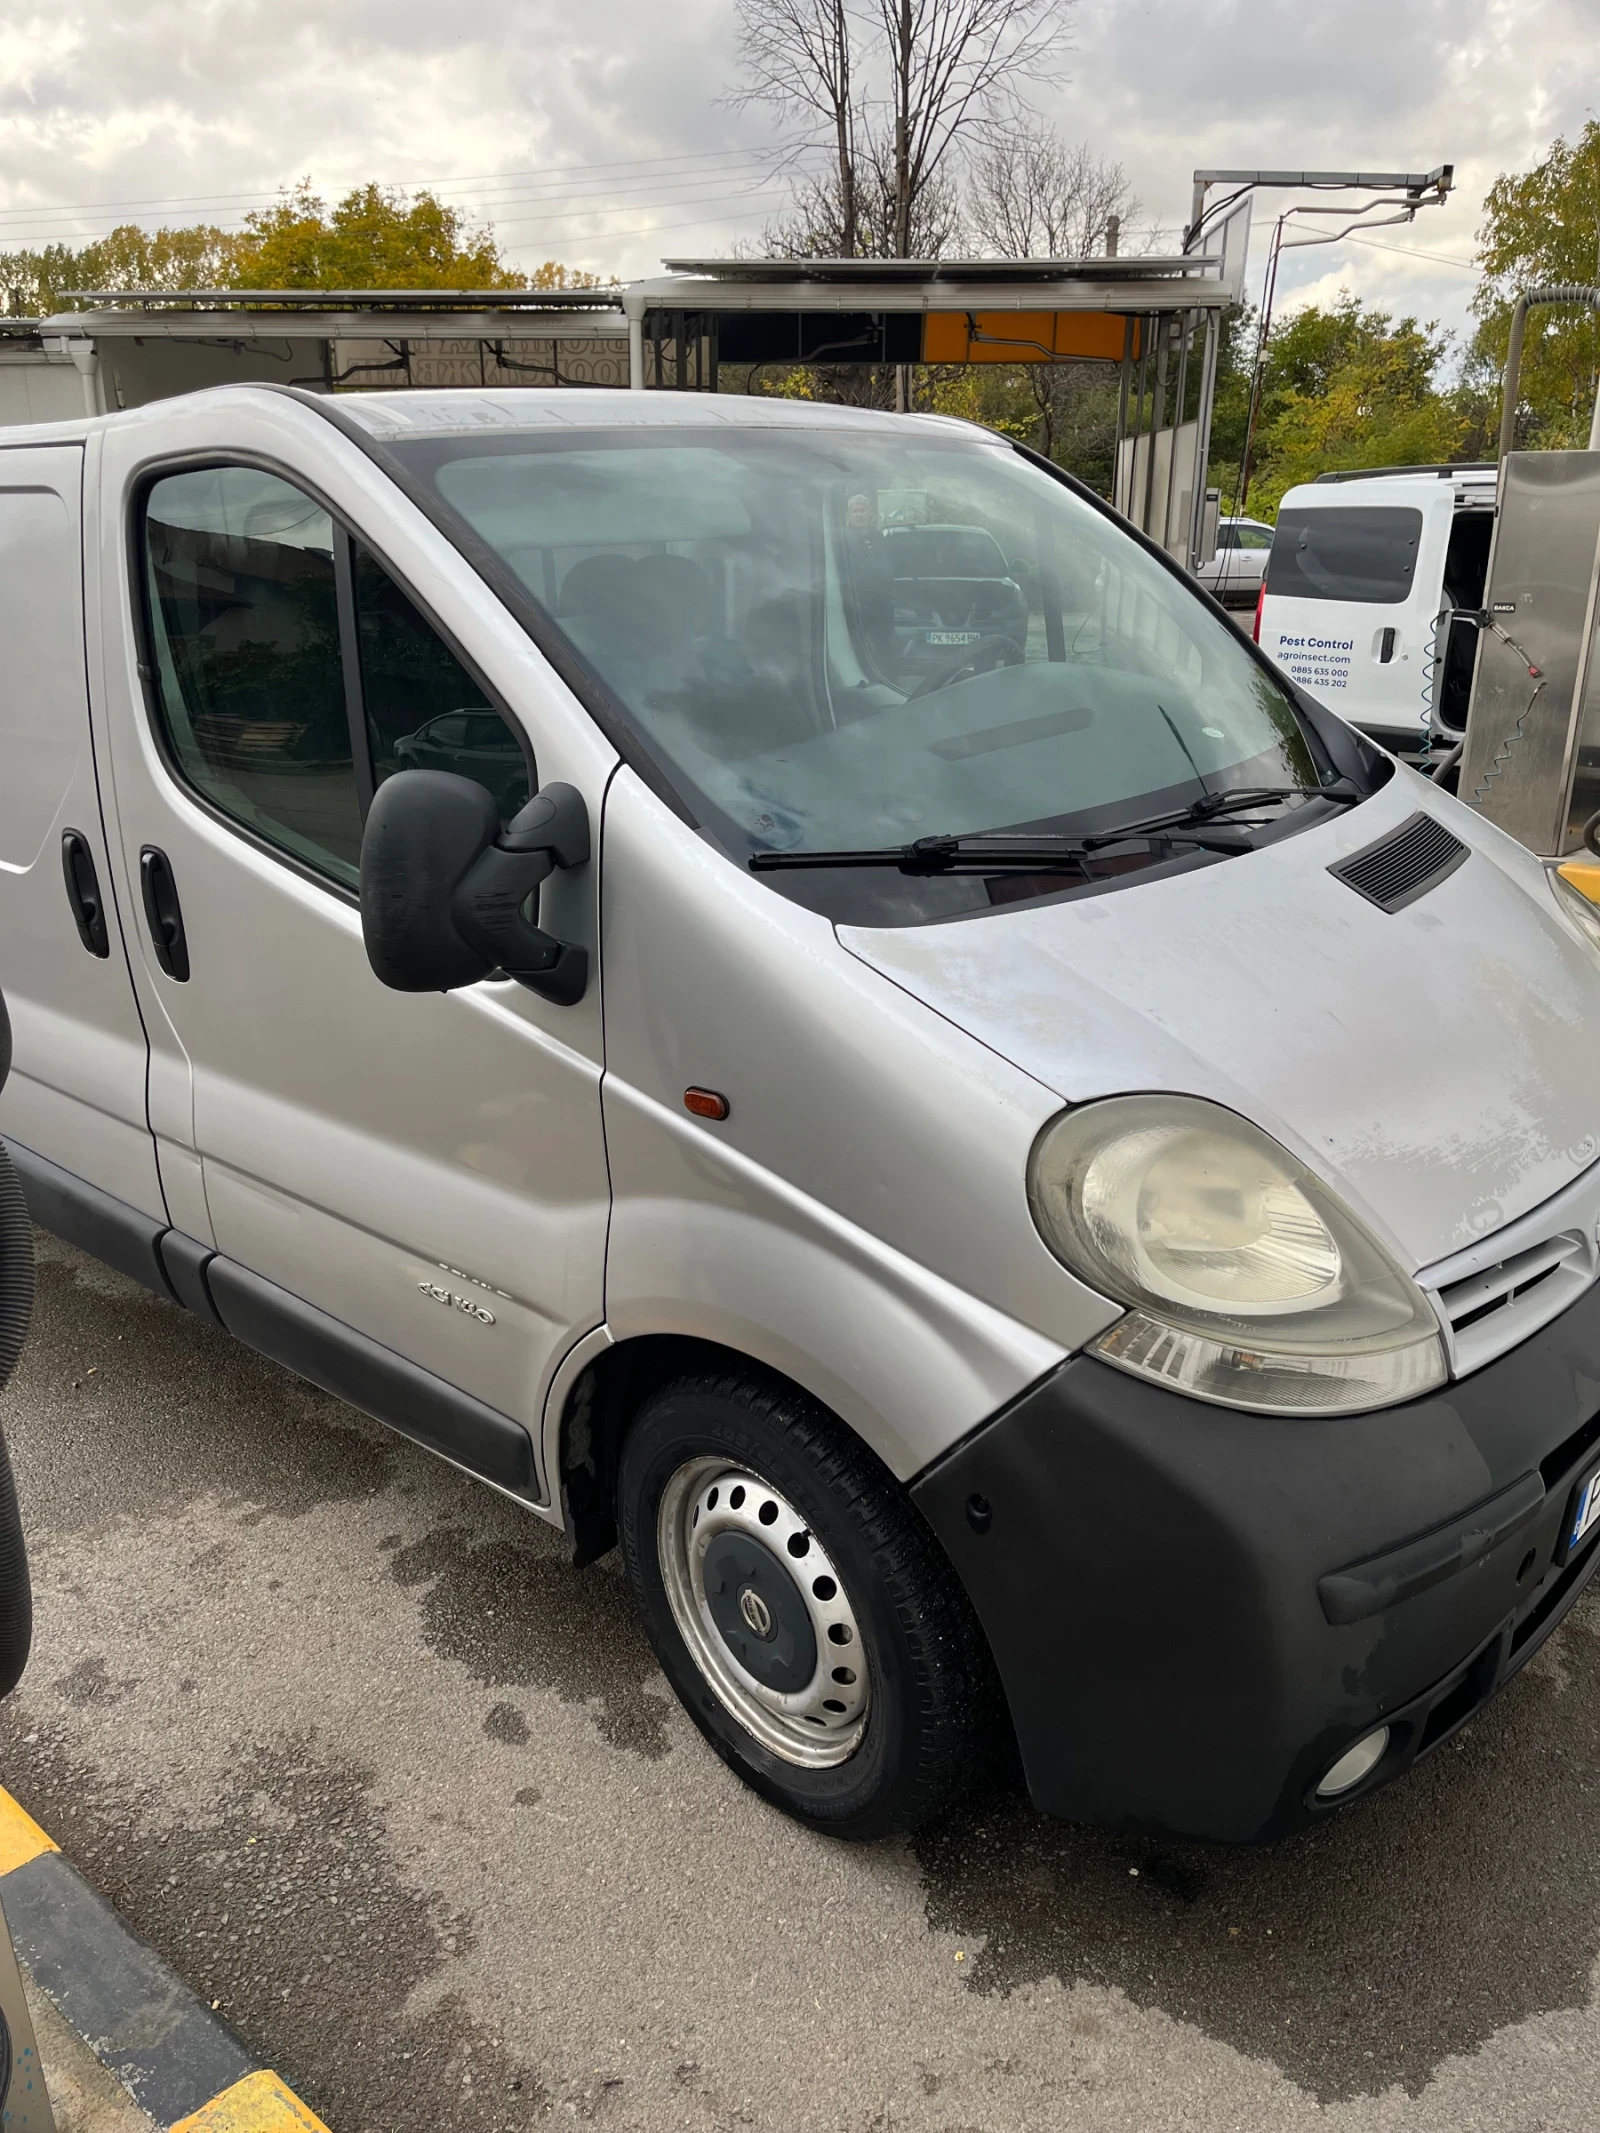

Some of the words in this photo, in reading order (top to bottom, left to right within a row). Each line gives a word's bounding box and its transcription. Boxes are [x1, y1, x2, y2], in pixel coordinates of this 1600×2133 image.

[1280, 636, 1305, 646] Pest
[1308, 638, 1353, 650] Control
[1277, 652, 1351, 663] agroinsect.com
[1291, 666, 1312, 675] 0885
[1314, 667, 1329, 676] 635
[1331, 669, 1348, 677] 000
[1314, 678, 1329, 686] 435
[1331, 679, 1347, 688] 202
